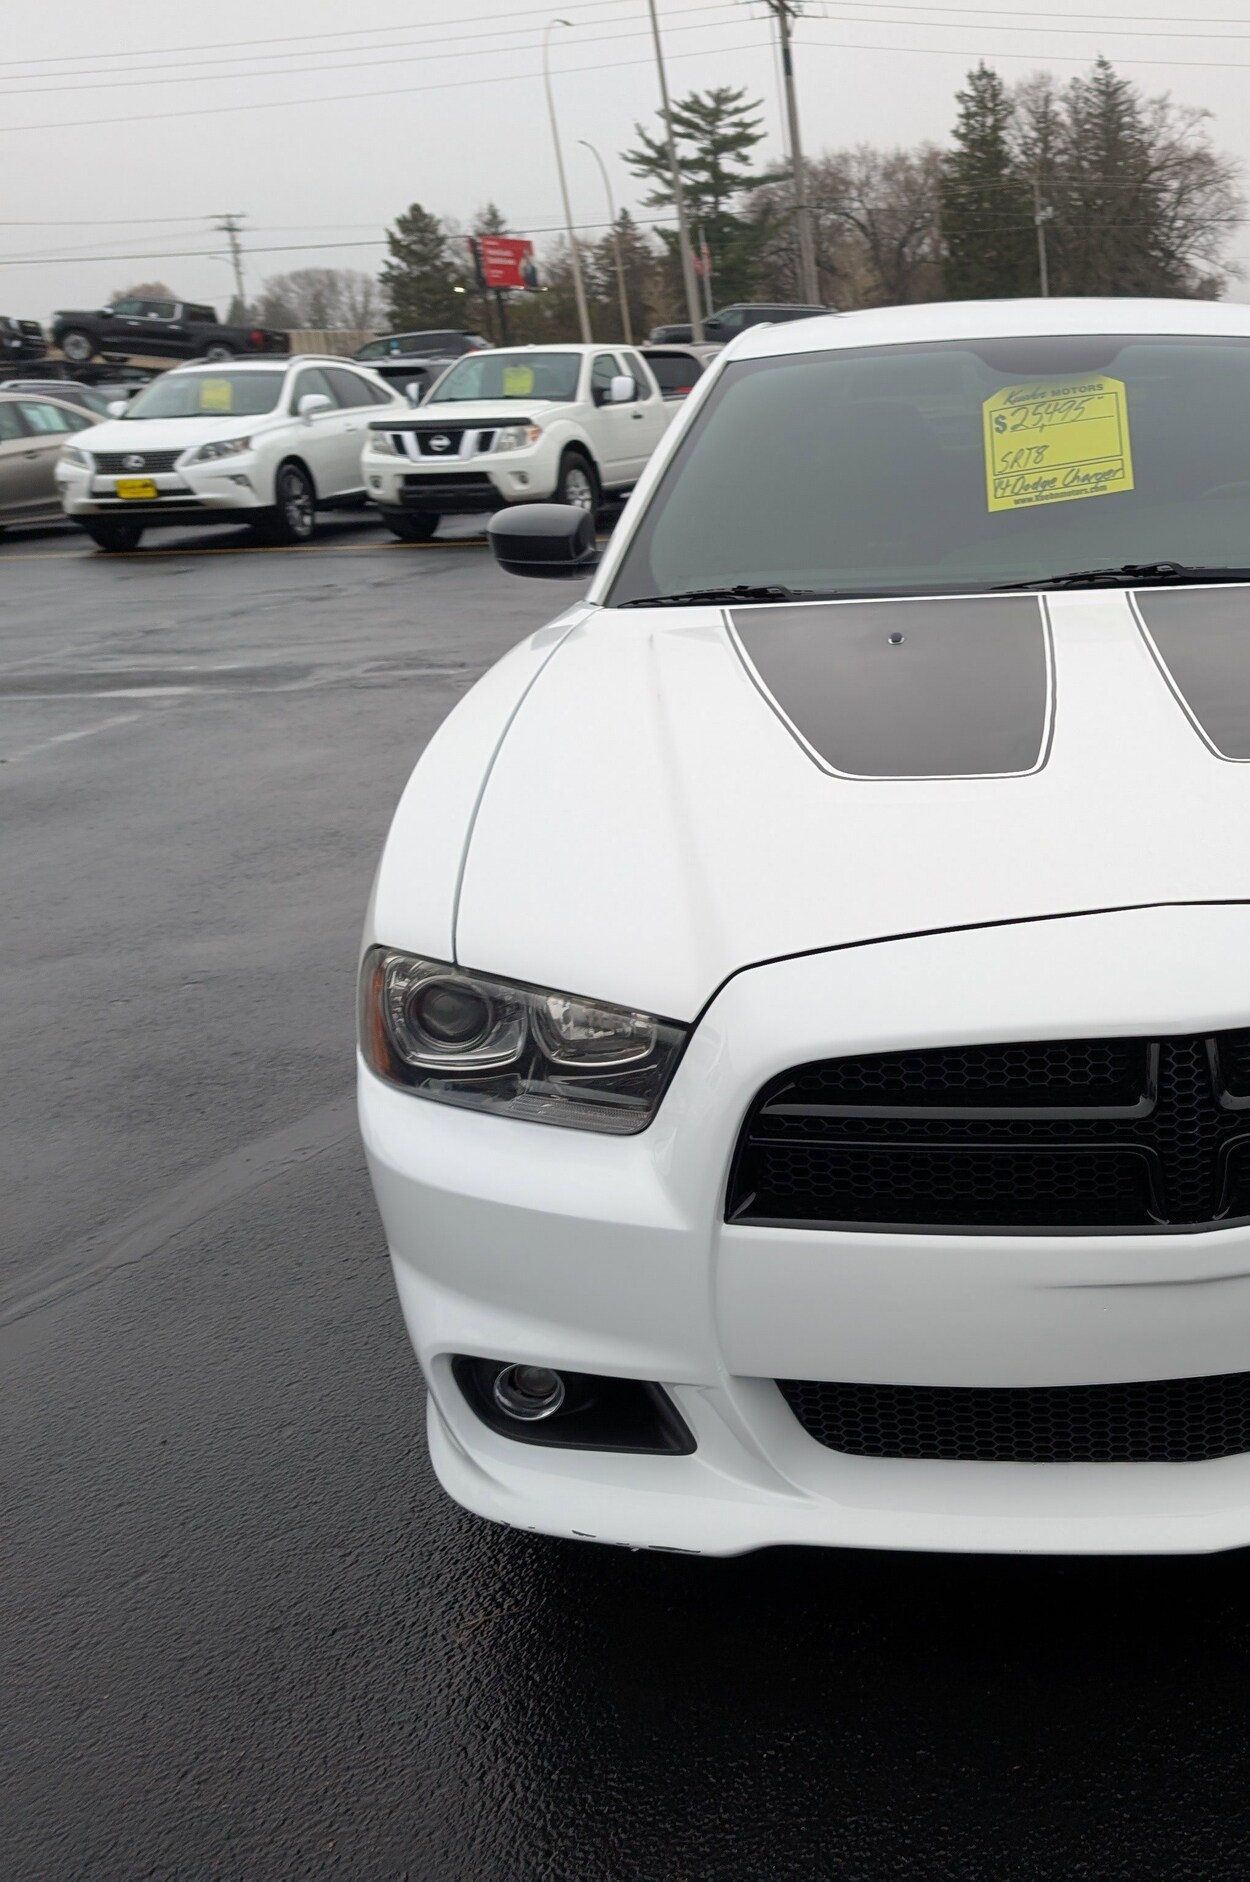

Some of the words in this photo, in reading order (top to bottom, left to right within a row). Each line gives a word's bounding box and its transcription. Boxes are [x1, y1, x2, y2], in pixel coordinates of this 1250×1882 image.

[1051, 383, 1104, 396] MOTORS
[998, 445, 1050, 473] SRT8
[1011, 476, 1058, 496] Dodge
[1062, 468, 1124, 488] Charger
